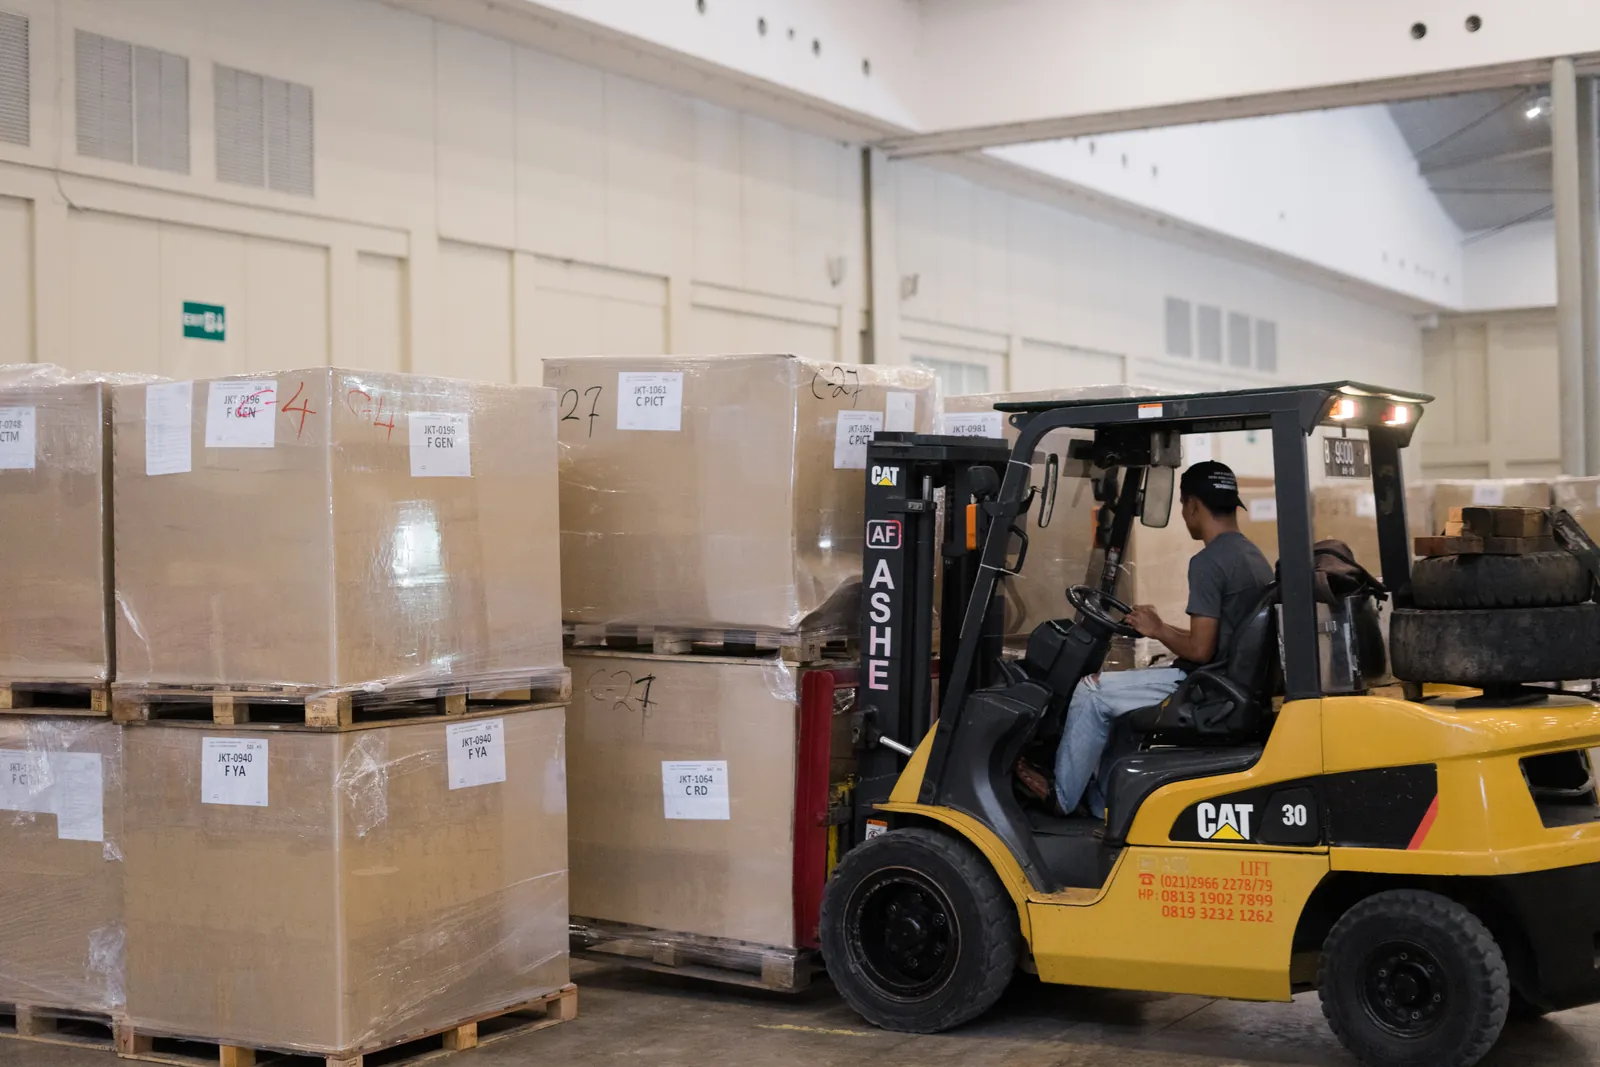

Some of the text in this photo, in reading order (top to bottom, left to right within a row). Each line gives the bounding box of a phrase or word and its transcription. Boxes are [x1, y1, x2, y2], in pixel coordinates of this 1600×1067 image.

[634, 385, 667, 395] JKT-1061
[635, 396, 665, 407] C PICT
[227, 407, 257, 418] F GEN
[424, 425, 456, 435] JKT-0196
[848, 425, 873, 433] JKT-1061
[952, 424, 987, 434] JKT-0981
[427, 437, 454, 448] F GEN
[849, 435, 871, 445] C PICT
[871, 465, 900, 486] CAT
[871, 525, 896, 543] AF
[868, 558, 895, 690] ASHE
[462, 733, 492, 748] JKT-0940
[218, 753, 253, 763] JKT-0940
[468, 746, 488, 760] F YA
[225, 765, 246, 776] F YA
[679, 775, 713, 783] JKT-1064
[685, 785, 708, 795] C RD
[1281, 804, 1307, 826] 30
[1197, 802, 1253, 840] CAT
[1241, 861, 1272, 876] LIFT
[1161, 874, 1273, 892] (021)2966 2278/79
[1161, 890, 1195, 903] 0813
[1200, 892, 1234, 905] 1902
[1238, 893, 1273, 907] 7899
[1162, 905, 1273, 923] 0819 3232 1262
